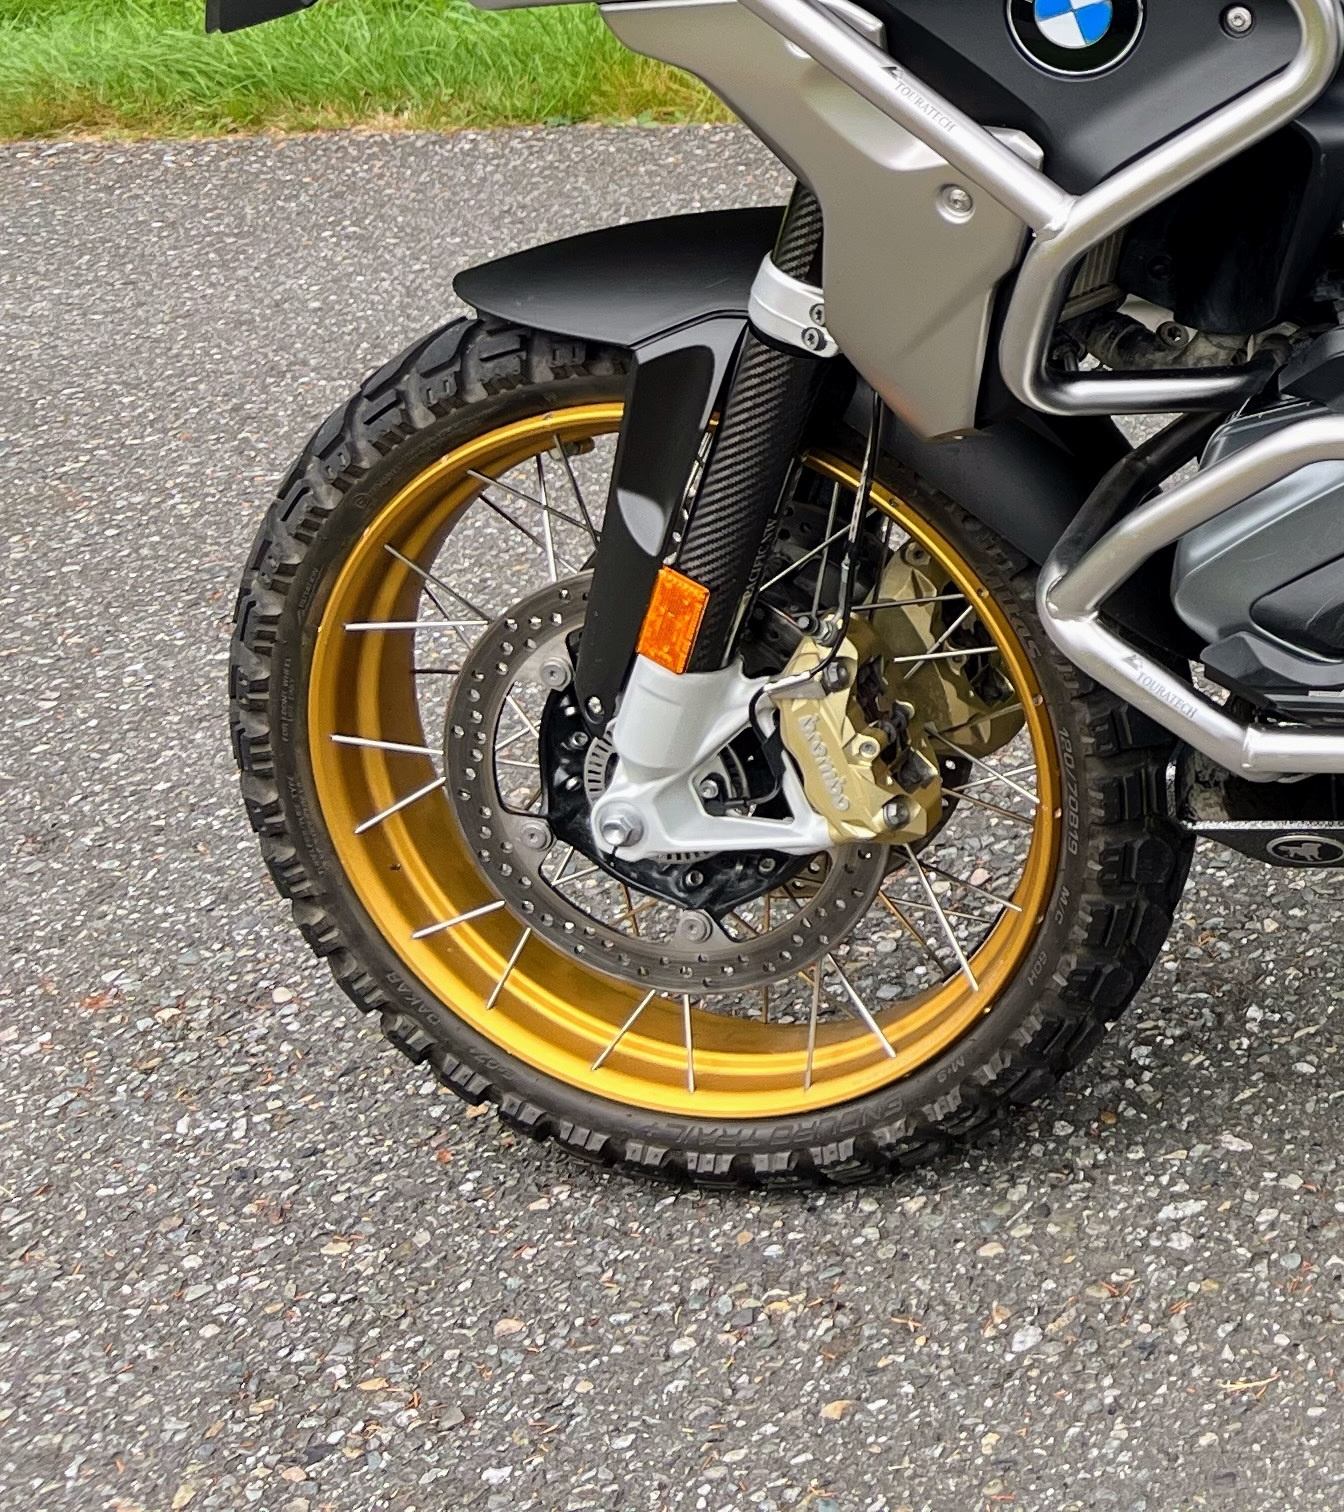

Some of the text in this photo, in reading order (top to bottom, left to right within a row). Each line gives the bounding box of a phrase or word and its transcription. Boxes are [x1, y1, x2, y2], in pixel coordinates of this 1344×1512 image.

[894, 80, 957, 133] TOURATECH
[1136, 670, 1199, 719] TOURATECH
[798, 712, 850, 811] brembo
[1056, 725, 1079, 855] 120/70B19
[1050, 885, 1071, 925] M/C
[1024, 950, 1048, 986] 60H
[384, 968, 443, 1026] DAKAR
[767, 1095, 906, 1145] ENDURO
